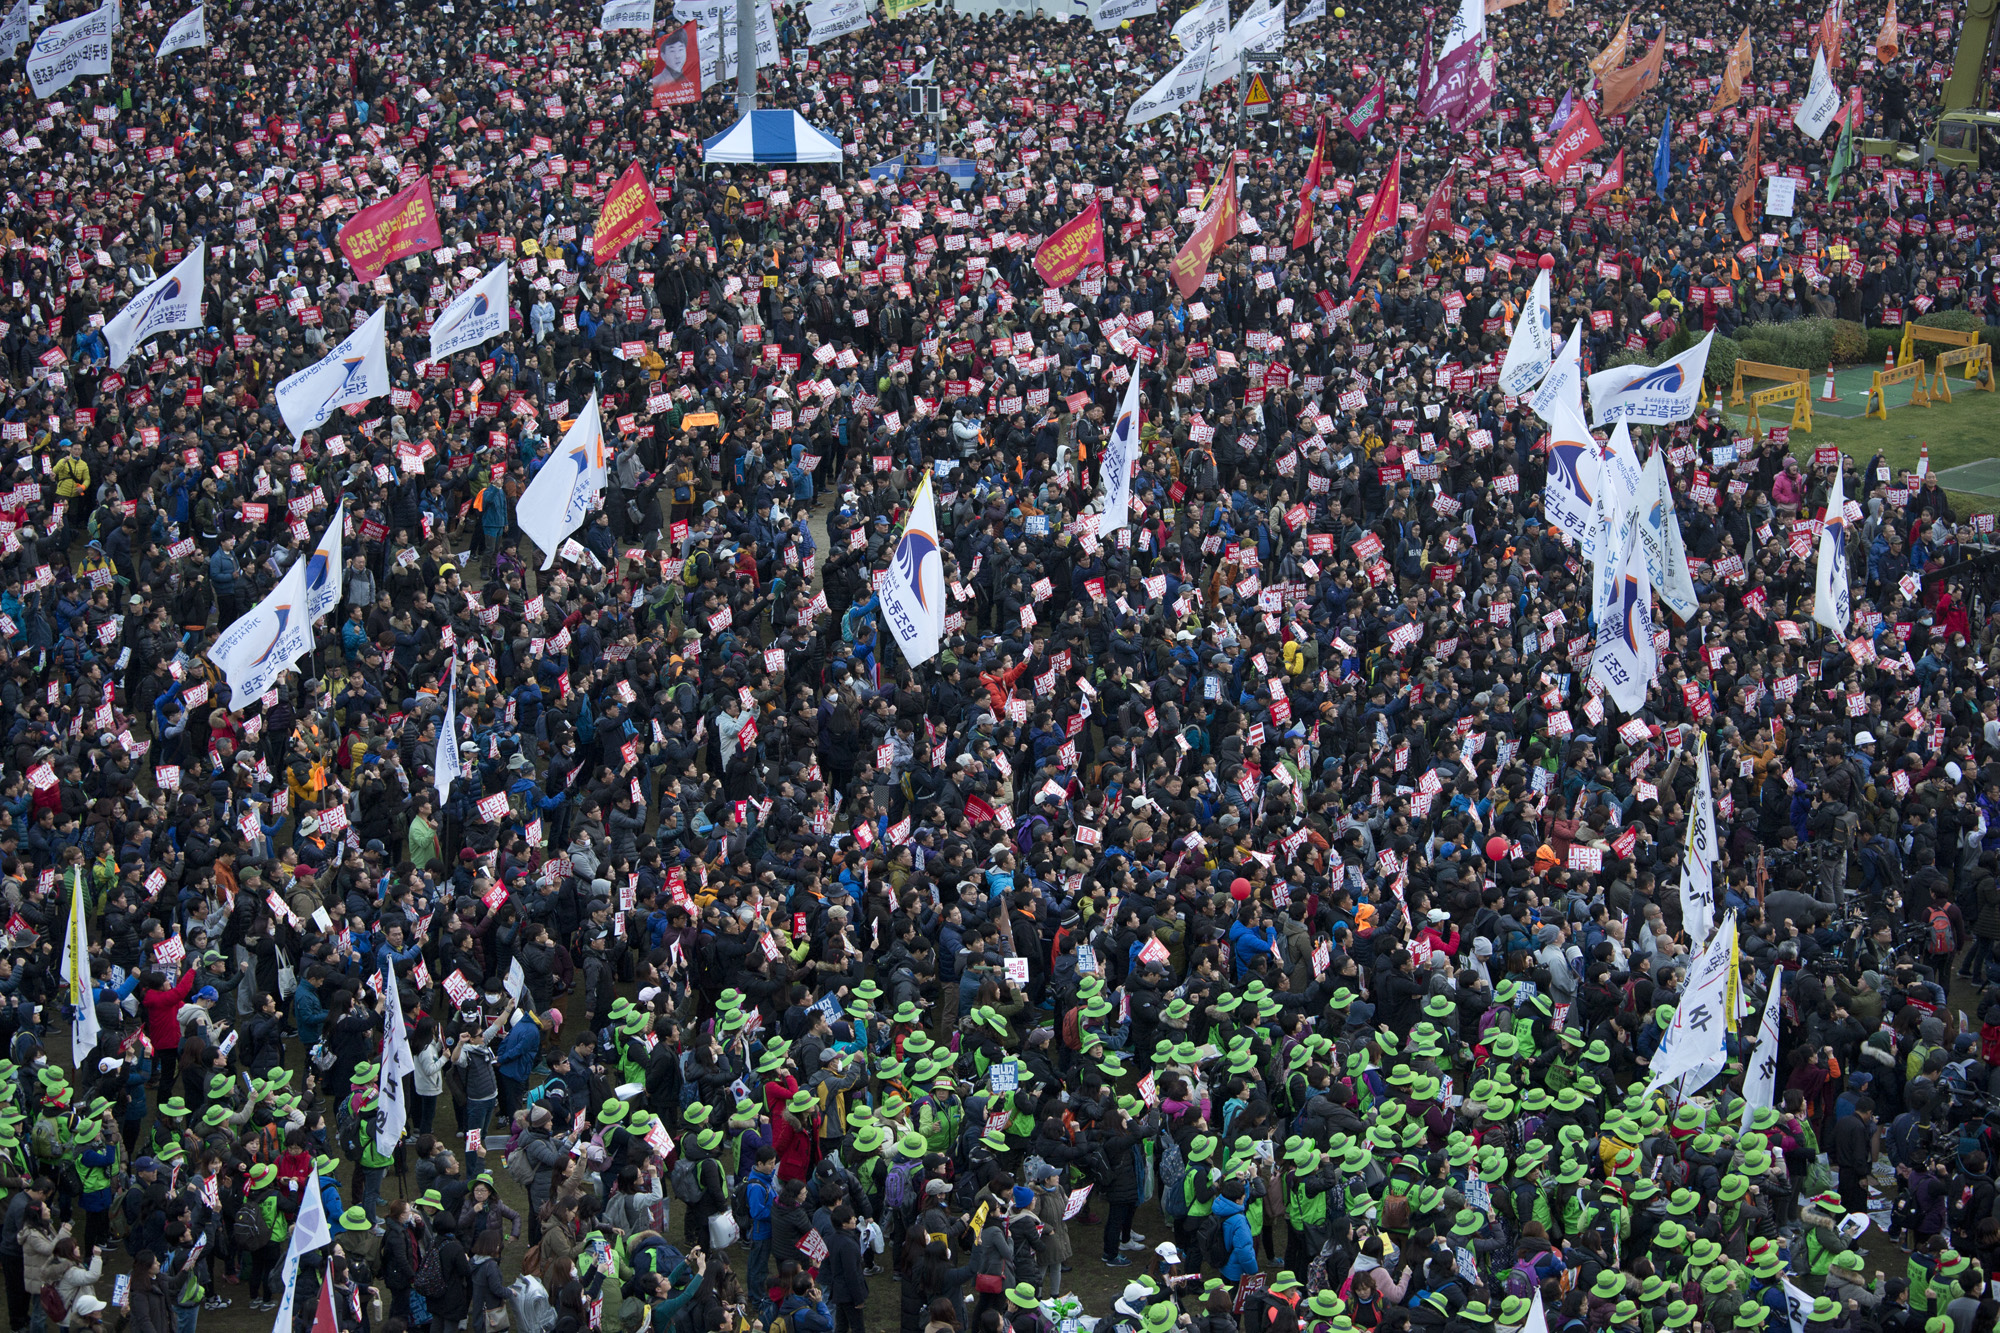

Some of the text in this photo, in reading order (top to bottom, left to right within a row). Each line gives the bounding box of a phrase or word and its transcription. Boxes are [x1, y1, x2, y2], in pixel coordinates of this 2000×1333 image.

[945, 235, 965, 243] 내려와
[1081, 280, 1101, 288] 내려와
[259, 297, 277, 305] 박근혜는
[687, 310, 706, 319] 내려와
[1246, 332, 1267, 340] 내려와
[44, 350, 59, 360] 박근혜는
[1193, 366, 1216, 376] 내려와
[1304, 376, 1324, 384] 내려와
[391, 390, 412, 398] 내려와
[1028, 389, 1049, 399] 내려와
[1340, 390, 1363, 402] 내려와
[649, 394, 671, 405] 내려와
[1001, 397, 1022, 407] 내려와
[800, 408, 820, 417] 내려와
[1001, 404, 1022, 414] 박근혜
[773, 412, 791, 422] 내려와
[3, 424, 26, 432] 내려와
[773, 420, 792, 429] 박근혜
[1393, 420, 1413, 428] 박근혜
[1190, 425, 1215, 435] 내려와
[1382, 467, 1400, 475] 박근혜는
[1493, 474, 1518, 487] 내려와
[1691, 485, 1717, 495] 내려와
[1887, 490, 1908, 498] 내려와
[289, 495, 311, 510] 내려와
[1027, 516, 1046, 524] 끝내자
[167, 538, 193, 552] 내려와
[1358, 539, 1376, 551] 박근혜는
[1714, 556, 1739, 568] 내려와
[1490, 604, 1510, 614] 내려와
[1434, 638, 1458, 651] 내려와
[1775, 675, 1797, 690] 내려와
[1549, 712, 1570, 725] 내려와
[477, 792, 507, 813] 내려와
[319, 805, 345, 824] 내려와
[1569, 847, 1601, 859] 내려와
[1569, 859, 1601, 872] 박근혜
[990, 1064, 1015, 1075] 끝내자
